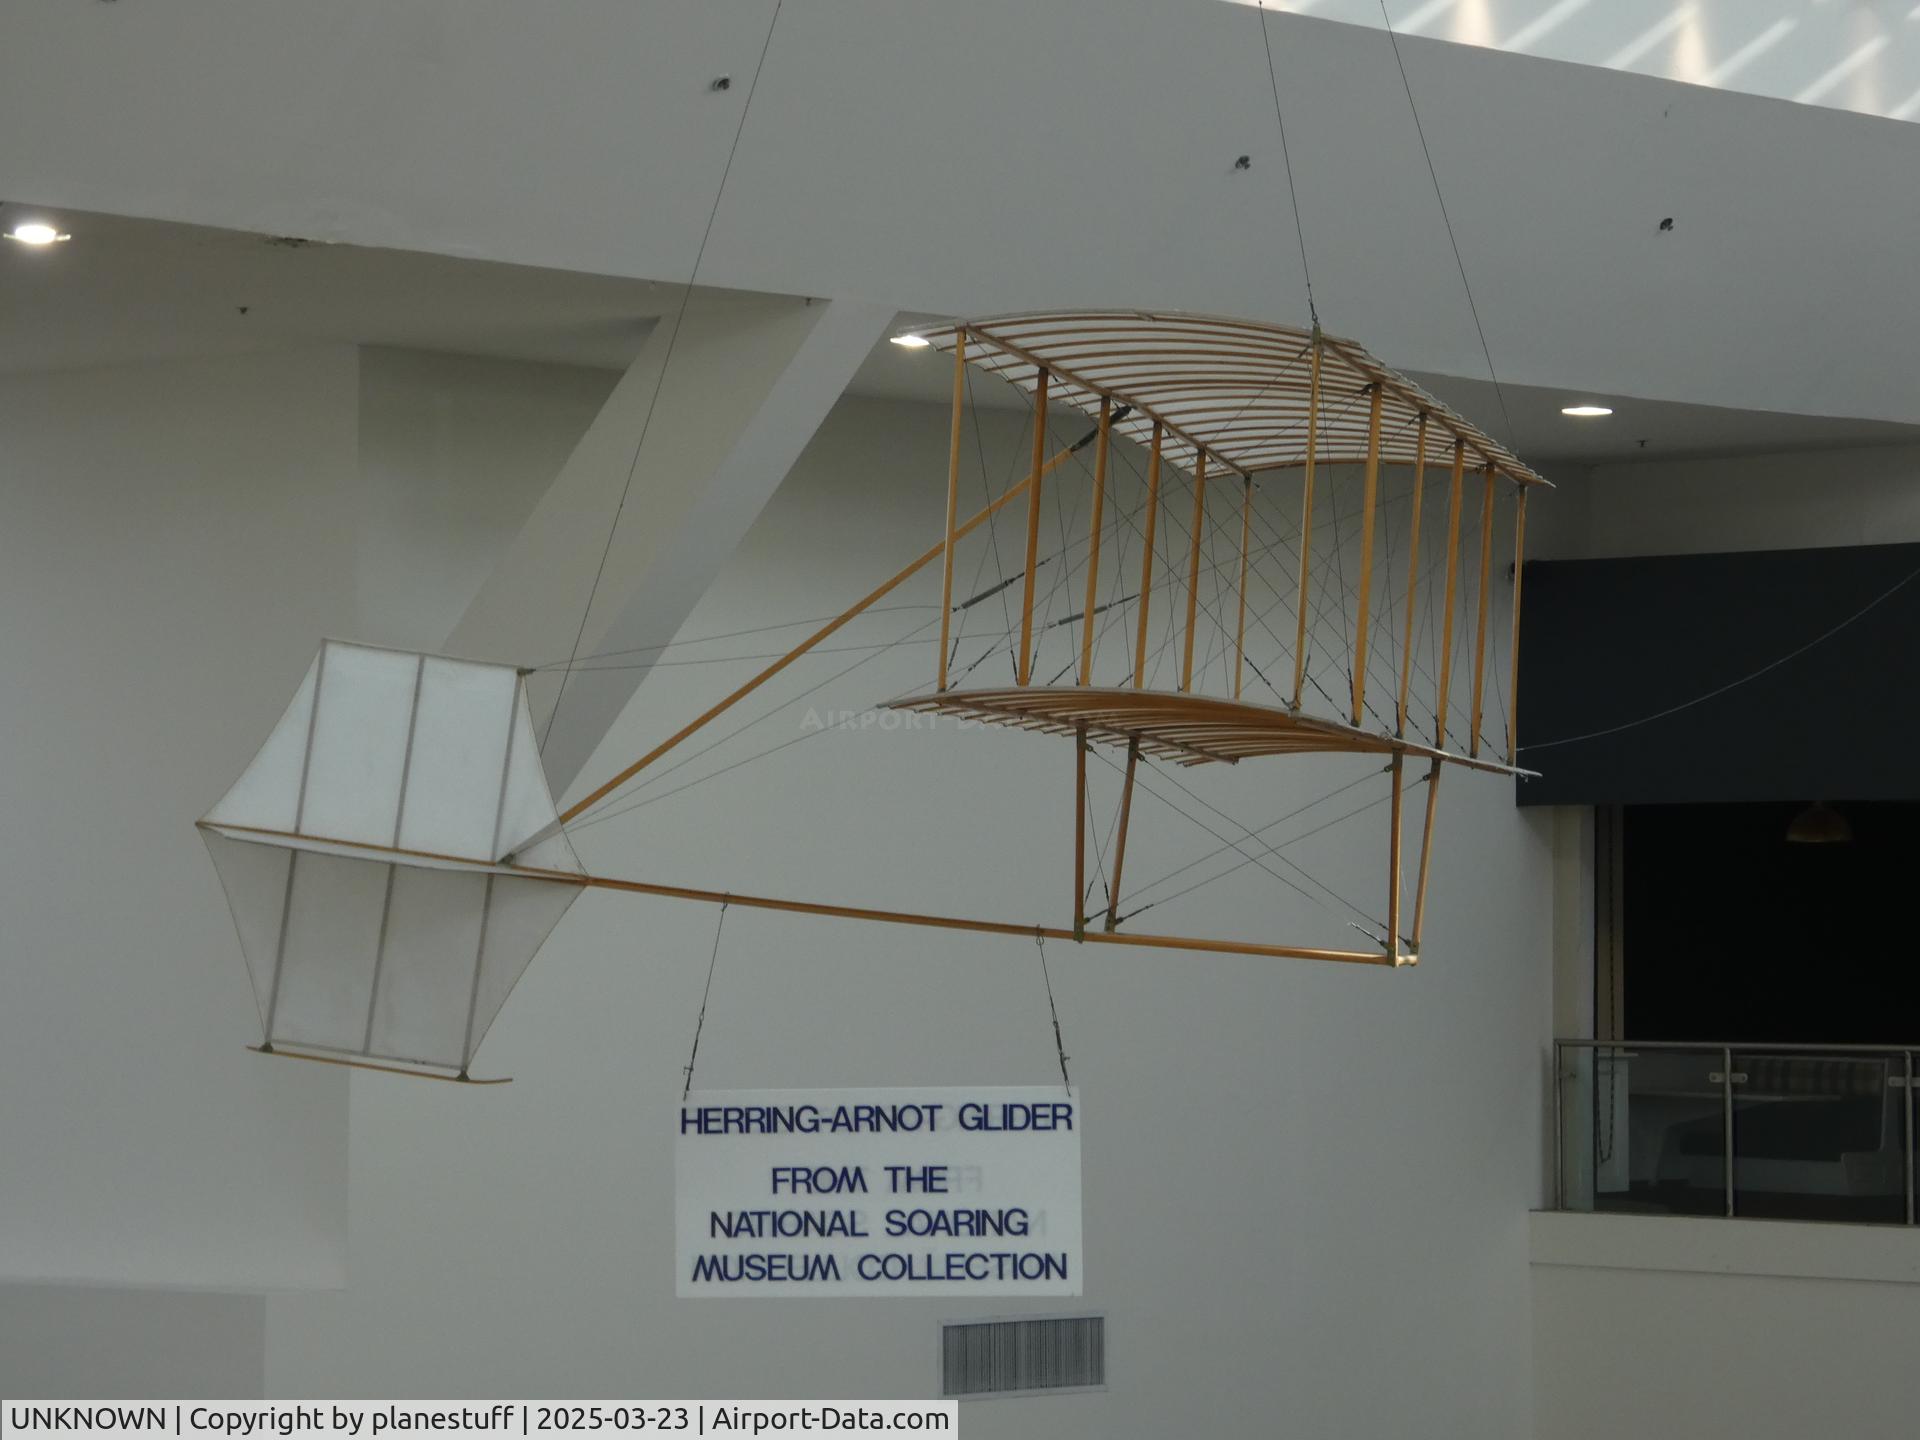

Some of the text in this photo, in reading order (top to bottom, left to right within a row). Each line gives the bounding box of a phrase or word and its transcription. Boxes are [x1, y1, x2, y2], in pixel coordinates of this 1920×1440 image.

[680, 1103, 1073, 1135] HERRING-ARNOT GLIDER
[772, 1166, 868, 1194] FROM
[884, 1166, 949, 1193] THE
[710, 1208, 1029, 1238] NATIONAL SOARING
[691, 1253, 1068, 1282] MUSEUM COLLECTION
